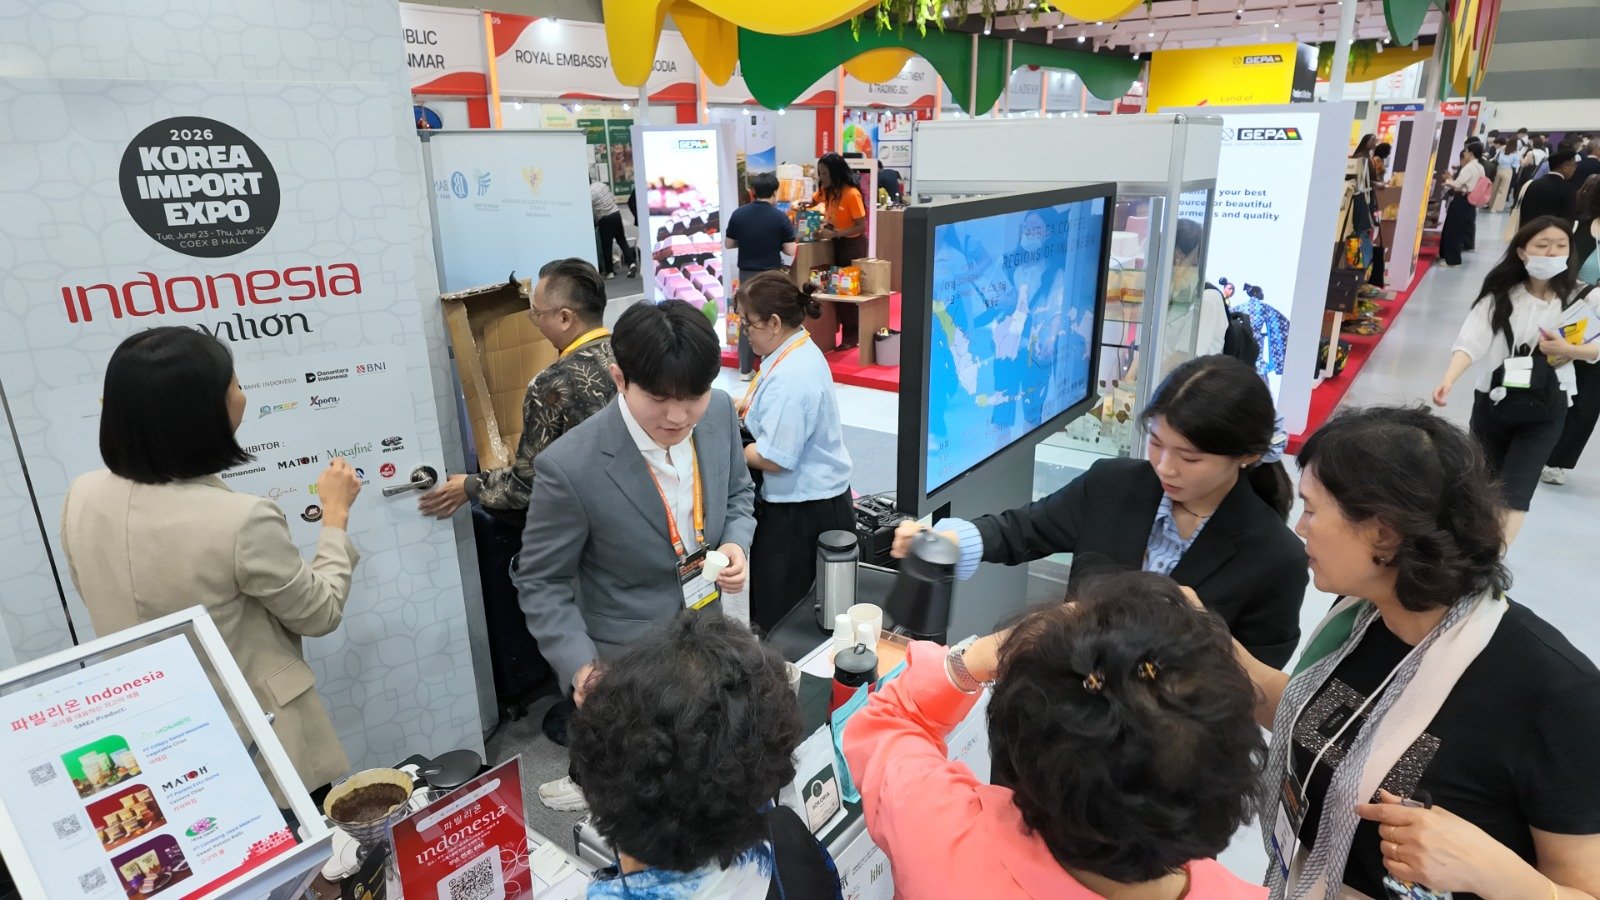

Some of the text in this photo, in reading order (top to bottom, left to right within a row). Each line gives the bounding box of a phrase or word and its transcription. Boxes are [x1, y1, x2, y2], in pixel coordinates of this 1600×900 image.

[403, 28, 438, 46] BLIC
[515, 49, 608, 69] ROYAL EMBASSY
[1245, 56, 1275, 64] GEPA
[651, 59, 677, 72] ODIA
[170, 129, 214, 141] 2026
[1240, 128, 1288, 140] GEPA
[138, 145, 253, 170] KOREA
[136, 172, 263, 200] IMPORT
[1244, 188, 1266, 196] best
[1226, 200, 1272, 208] beautiful
[163, 200, 250, 226] EXPO
[1244, 212, 1280, 221] quality
[156, 233, 174, 241] Tue,
[177, 232, 196, 240] June
[198, 230, 209, 238] 23
[235, 228, 254, 236] June
[180, 239, 208, 248] COEX
[222, 237, 248, 245] HALL
[196, 312, 314, 341] vilion
[317, 367, 349, 376] Danantara
[366, 362, 386, 373] BNI
[318, 373, 348, 382] Indonesia
[243, 378, 297, 390] BANK INDONESIA
[243, 442, 280, 454] HIBITOR
[10, 699, 81, 732] 파빌리온
[85, 669, 165, 705] Indonesia
[162, 766, 208, 792] MATOH
[444, 804, 482, 830] 파빌리온
